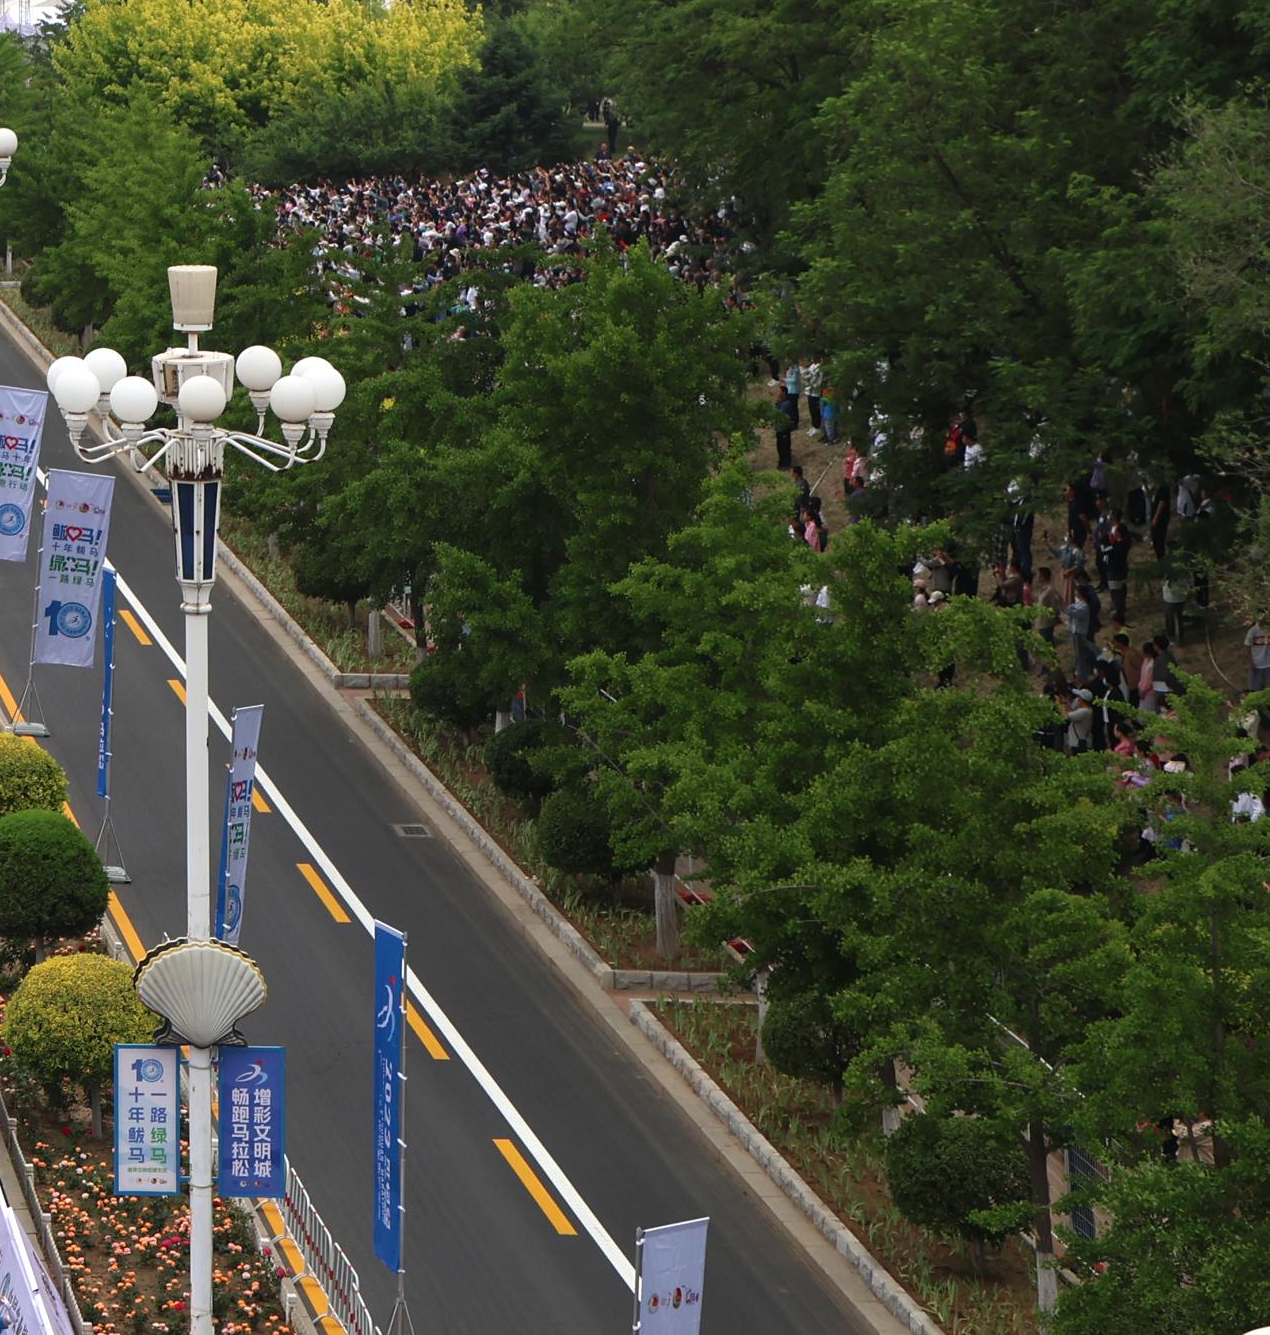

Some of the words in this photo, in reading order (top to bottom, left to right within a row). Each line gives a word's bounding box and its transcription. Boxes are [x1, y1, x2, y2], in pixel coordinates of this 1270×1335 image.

[131, 1058, 164, 1082] 10
[128, 1086, 145, 1164] 十年鲅马
[150, 1092, 167, 1164] 一路绿马
[231, 1088, 250, 1177] 畅跑马拉松
[253, 1088, 272, 1178] 增彩文明城
